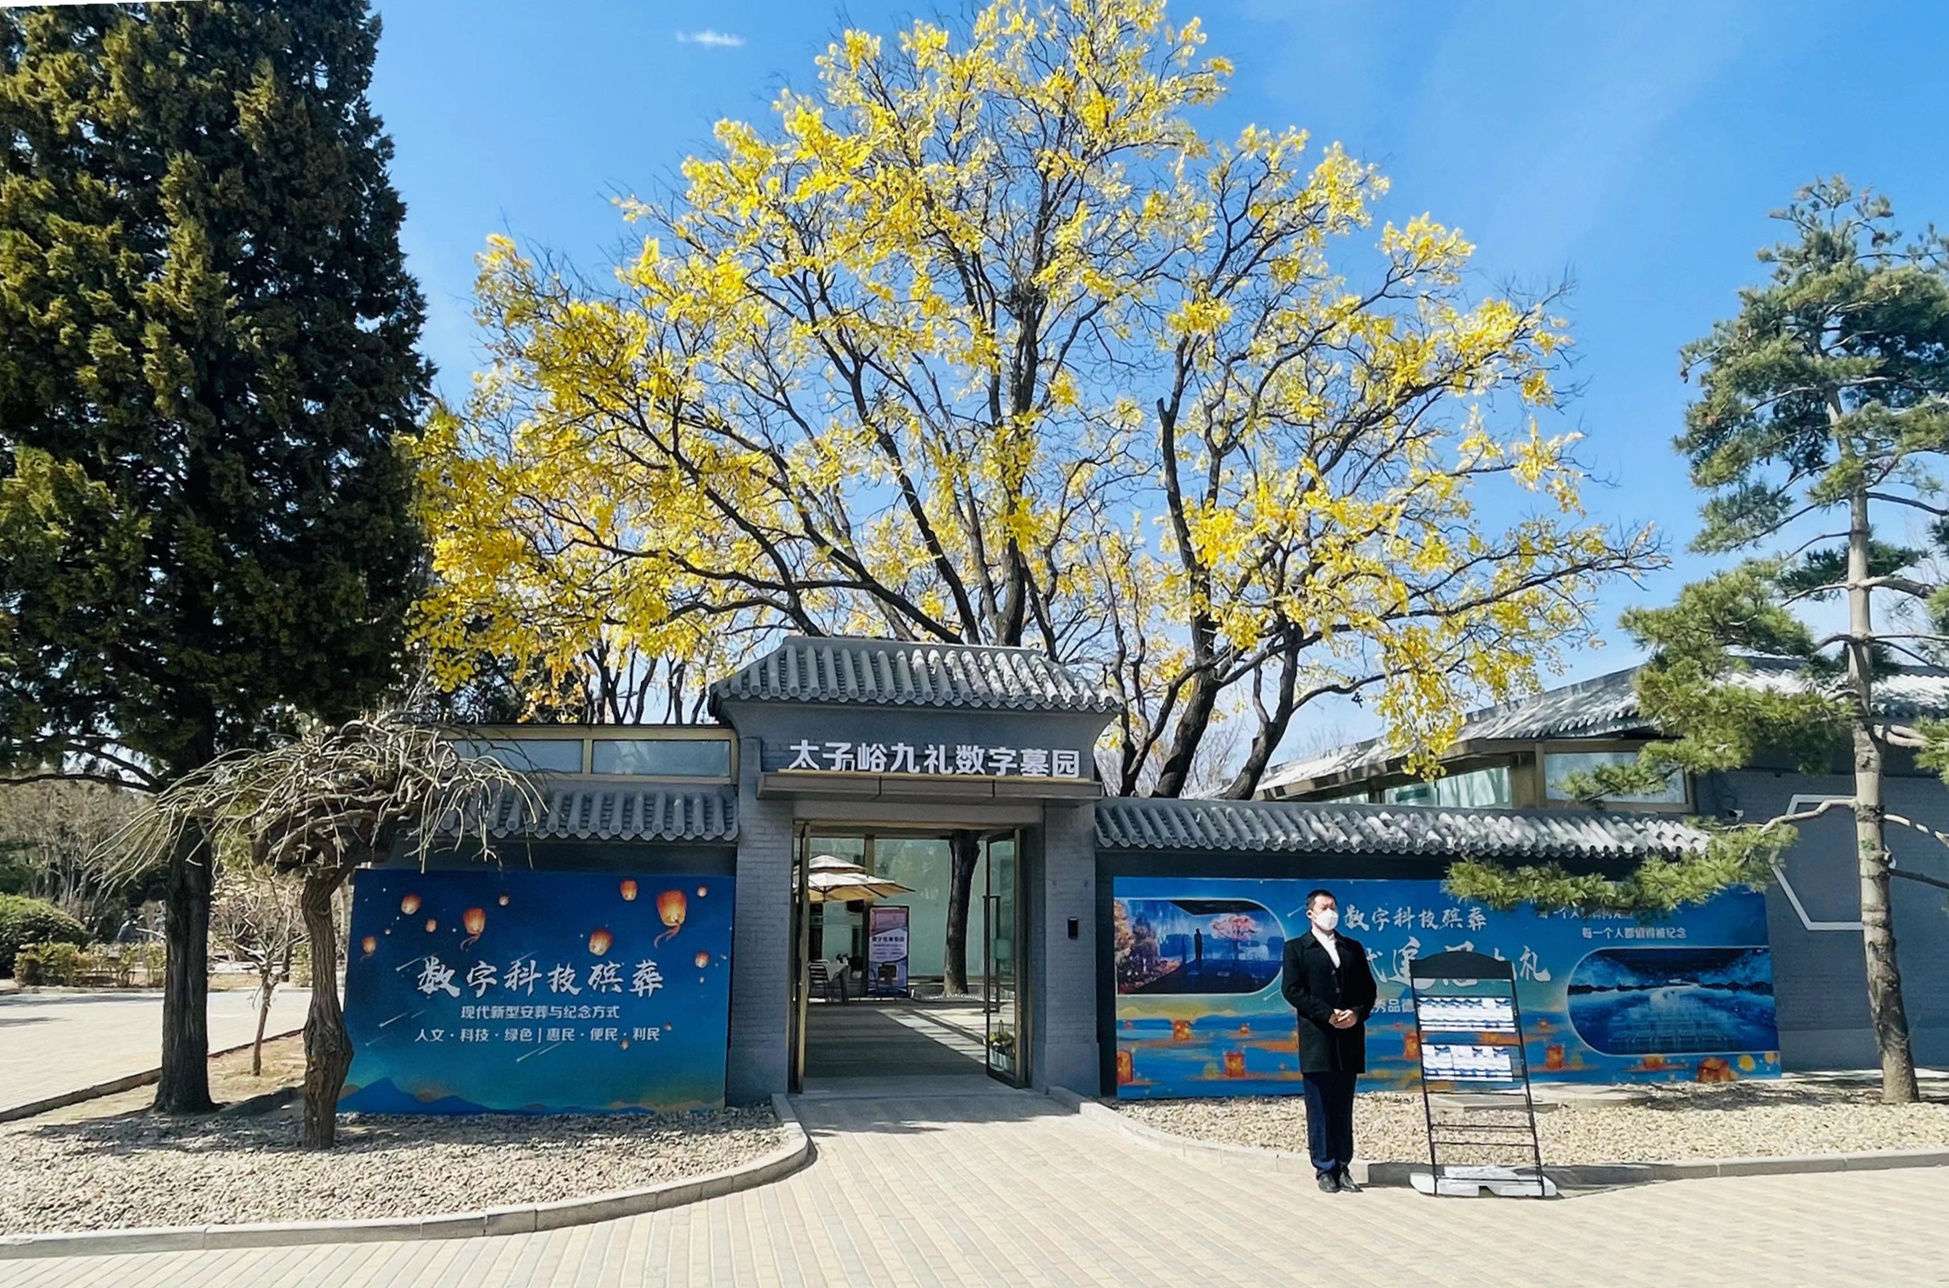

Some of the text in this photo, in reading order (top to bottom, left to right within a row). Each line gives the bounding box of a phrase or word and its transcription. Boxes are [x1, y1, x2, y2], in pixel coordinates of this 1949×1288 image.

[788, 739, 1080, 778] 太子峪九礼数字墓园
[1344, 904, 1487, 932] 数字科技殡葬
[416, 956, 664, 998] 数字科技殡葬
[460, 1005, 621, 1020] 现代新型安葬与纪念方式
